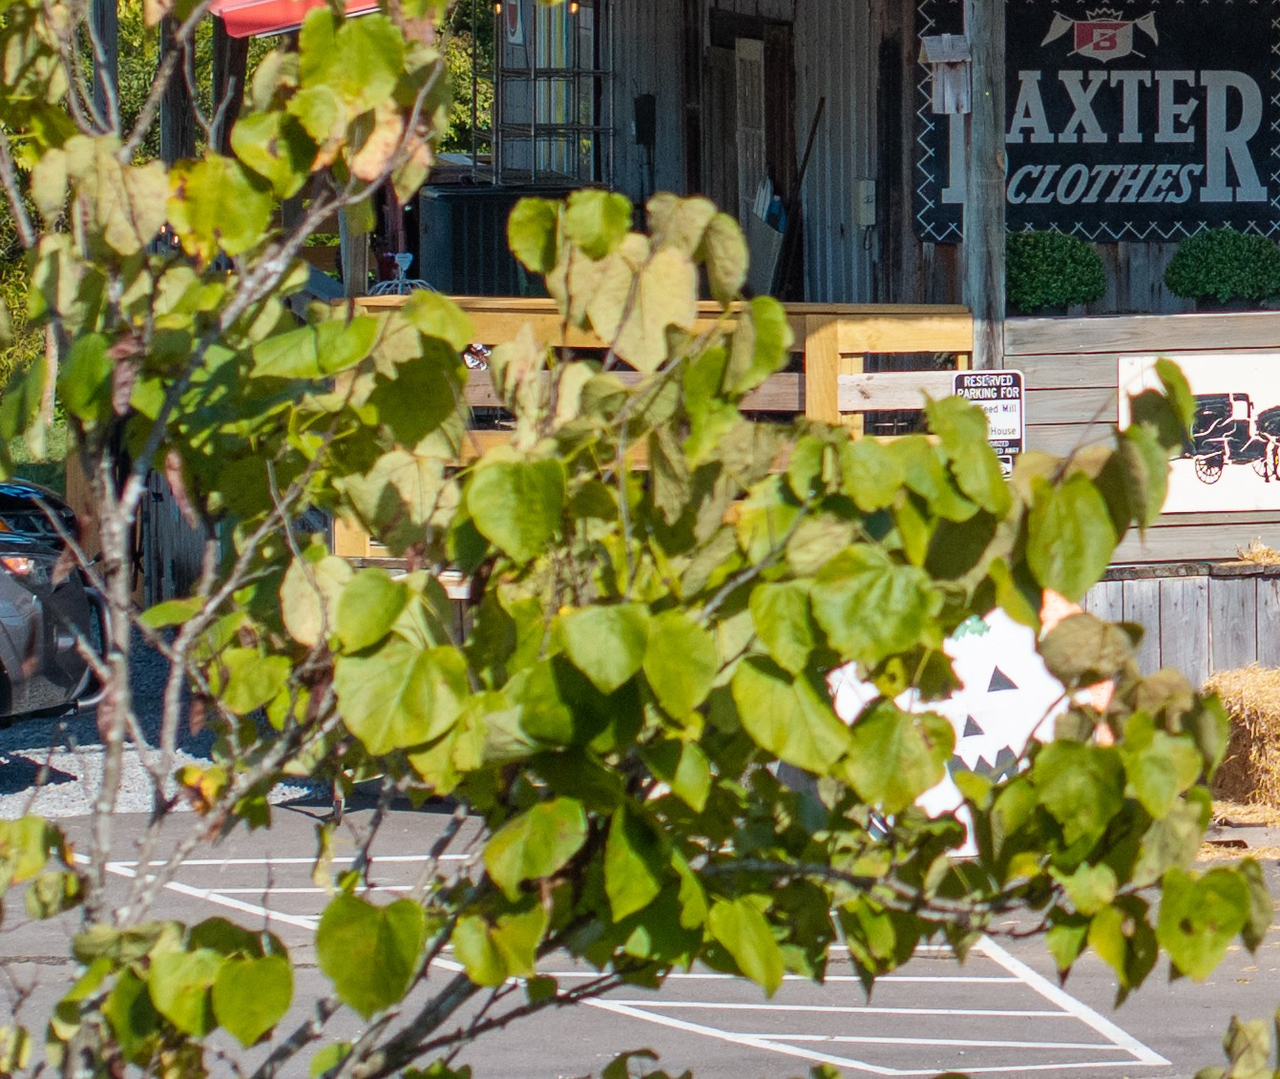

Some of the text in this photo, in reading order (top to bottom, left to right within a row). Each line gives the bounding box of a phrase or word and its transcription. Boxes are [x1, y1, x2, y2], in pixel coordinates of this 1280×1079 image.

[1006, 162, 1205, 205] CLOTHES
[964, 375, 1014, 388] RESERVED
[957, 386, 1020, 399] PARKING FOR
[1002, 404, 1017, 413] Mill
[990, 427, 1017, 436] House
